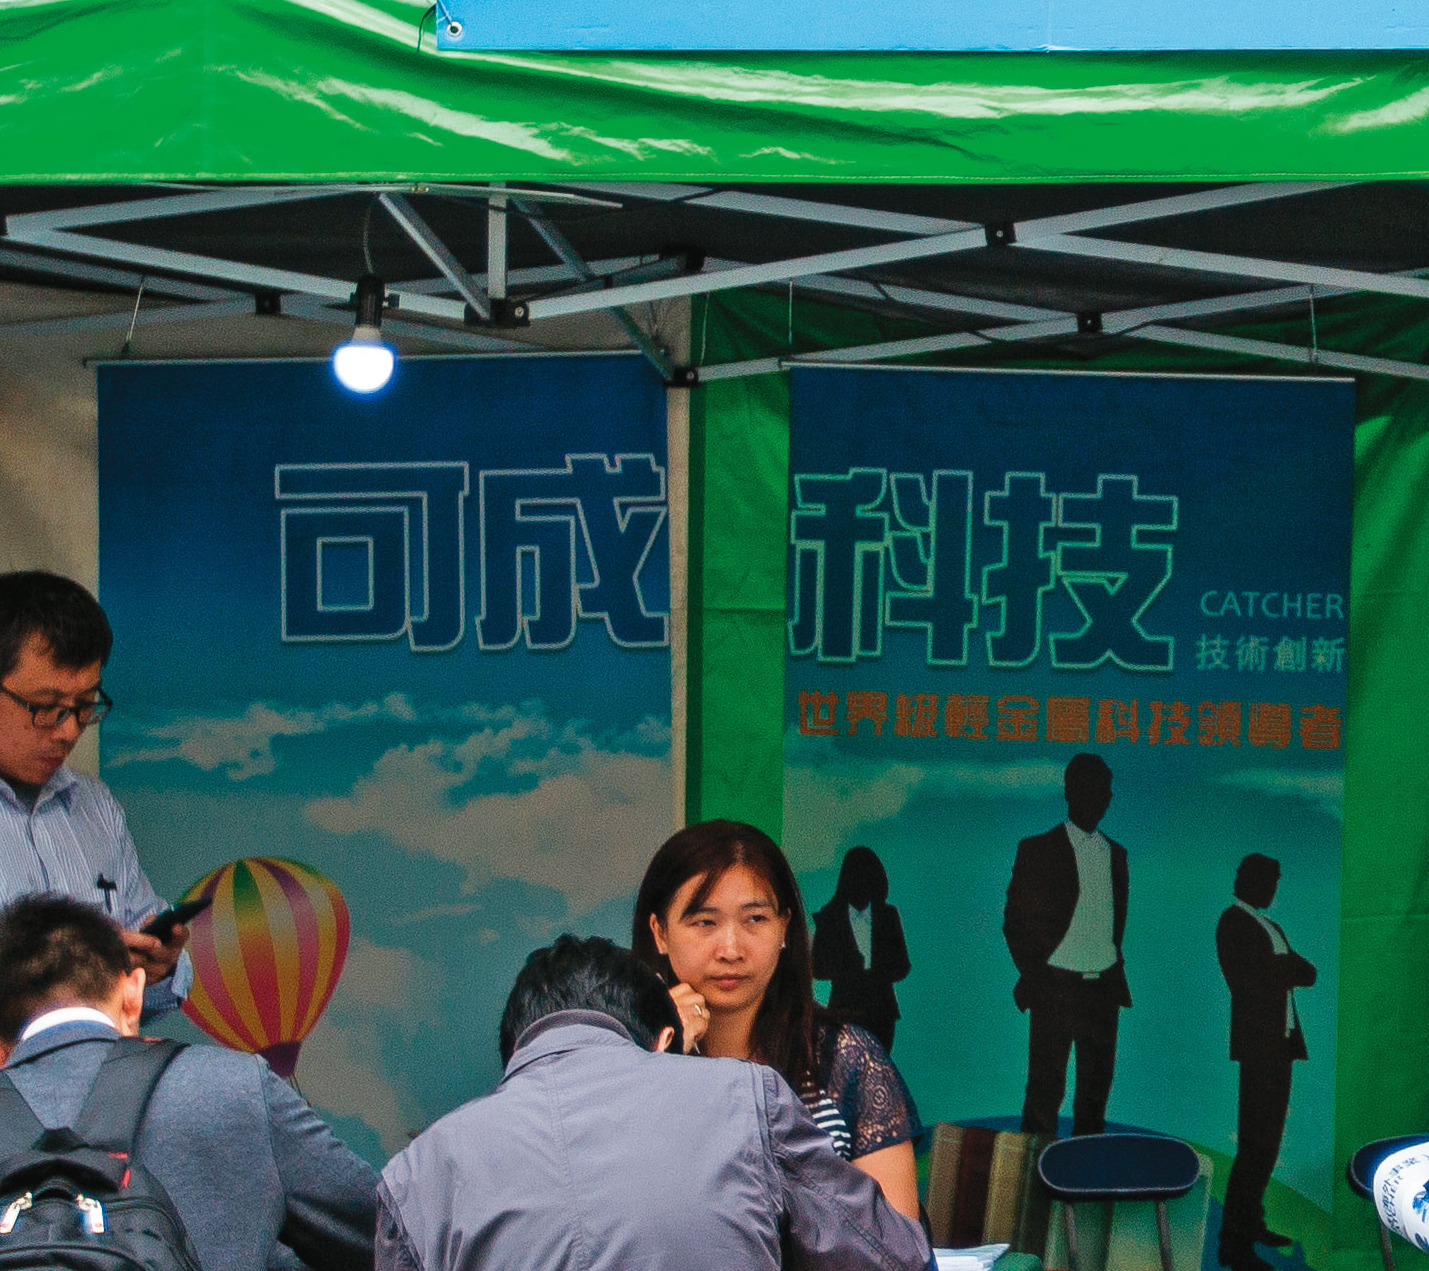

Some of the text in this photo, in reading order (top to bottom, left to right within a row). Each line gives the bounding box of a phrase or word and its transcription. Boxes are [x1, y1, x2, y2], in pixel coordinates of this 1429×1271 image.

[275, 454, 669, 651] 可成
[788, 468, 1178, 672] 科技
[1200, 589, 1345, 620] CATCHER
[1196, 633, 1346, 675] 技術創新
